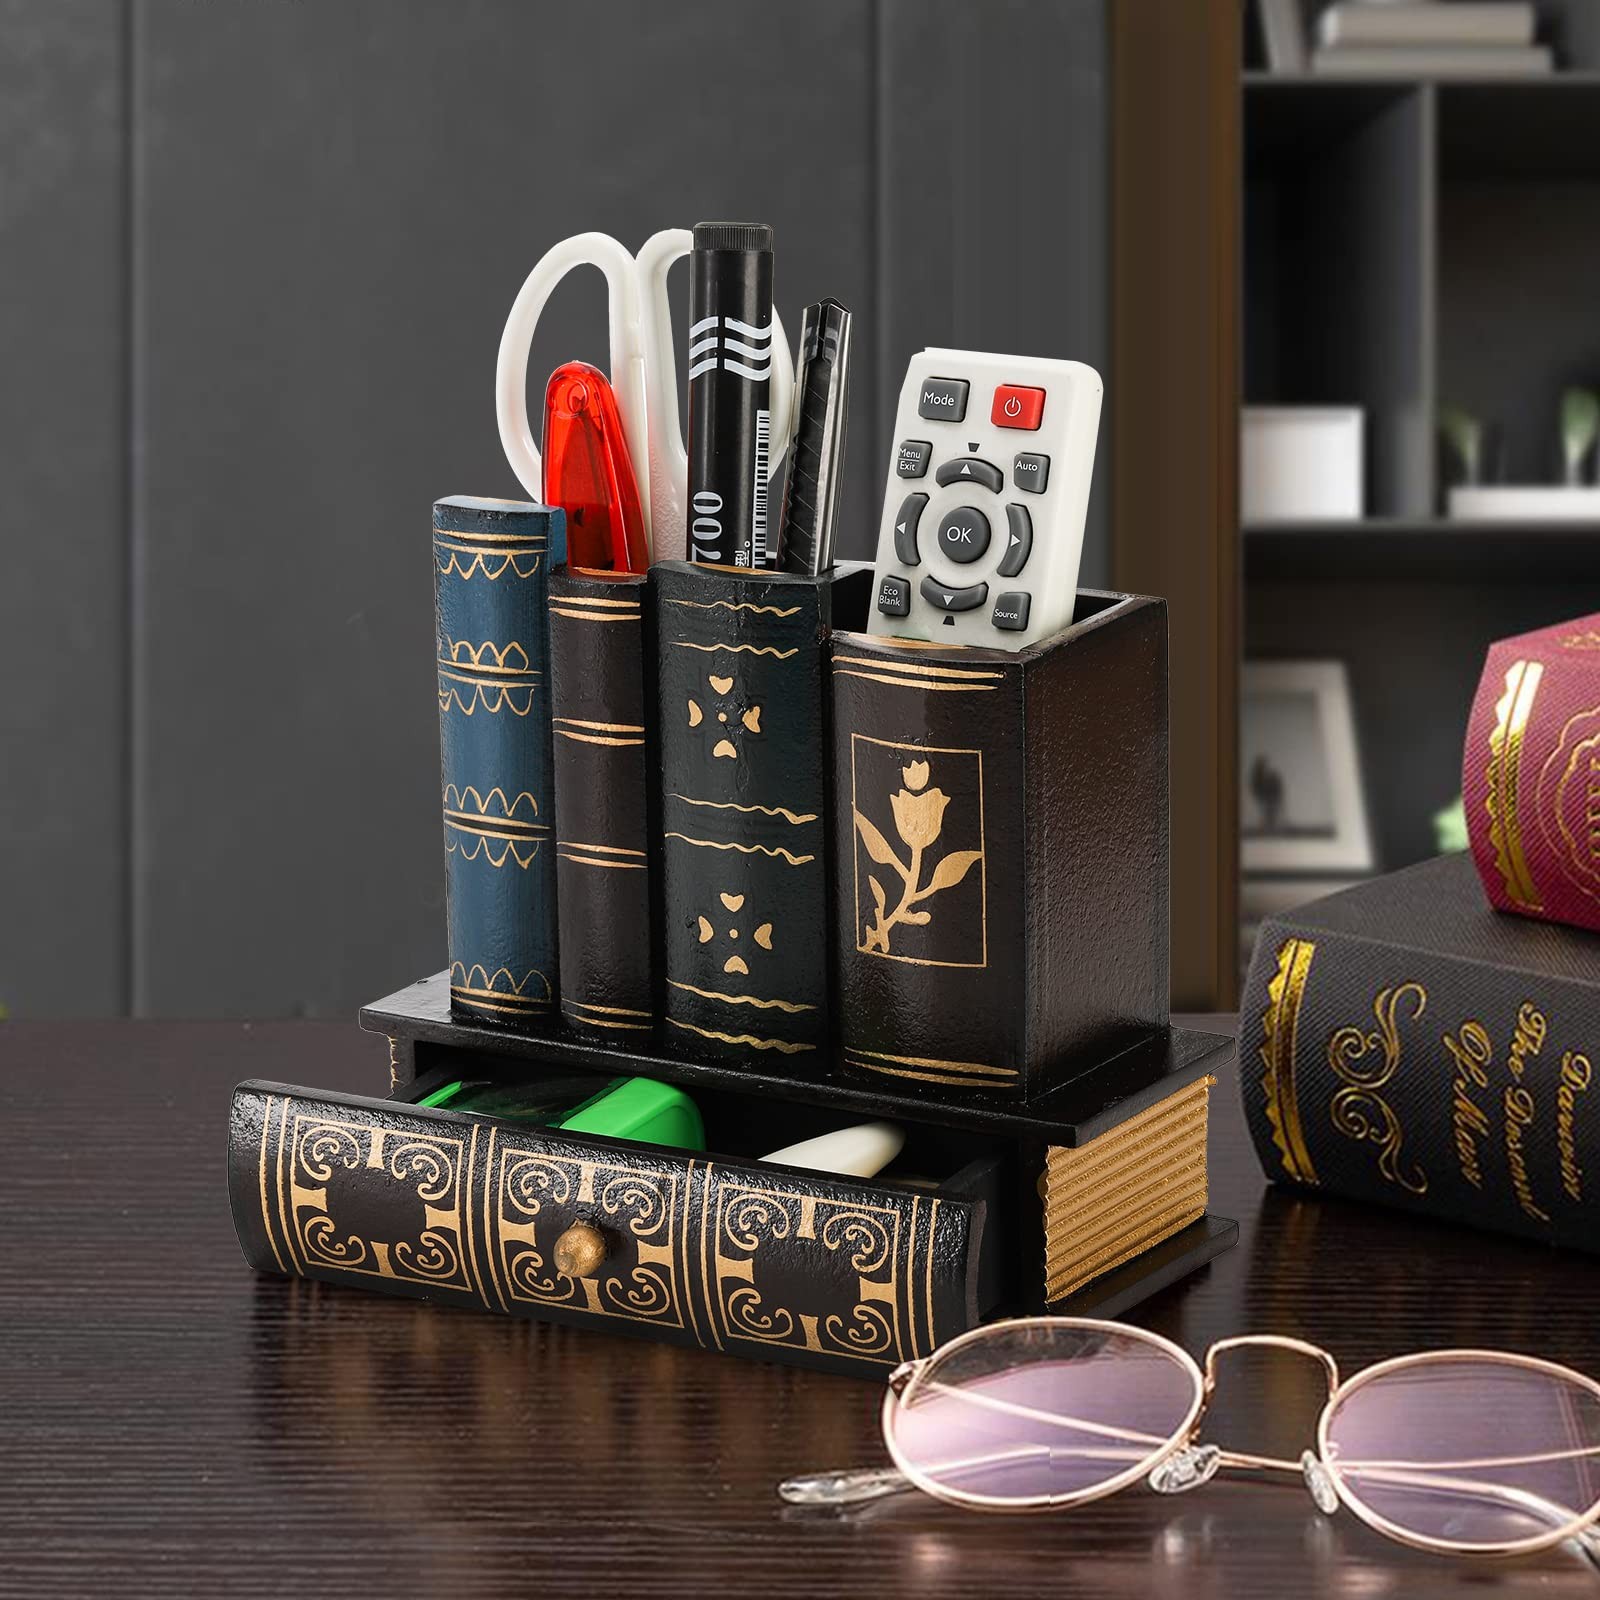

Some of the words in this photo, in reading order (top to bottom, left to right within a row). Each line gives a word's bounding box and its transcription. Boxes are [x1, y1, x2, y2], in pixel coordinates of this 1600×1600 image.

[923, 392, 955, 407] Mode
[899, 448, 921, 460] Menu
[899, 460, 916, 472] Exit
[1015, 460, 1038, 472] Auto
[946, 526, 973, 544] OK
[883, 585, 899, 596] Eco
[879, 595, 901, 607] Blank
[994, 609, 1018, 620] Source
[1507, 1000, 1547, 1082] The
